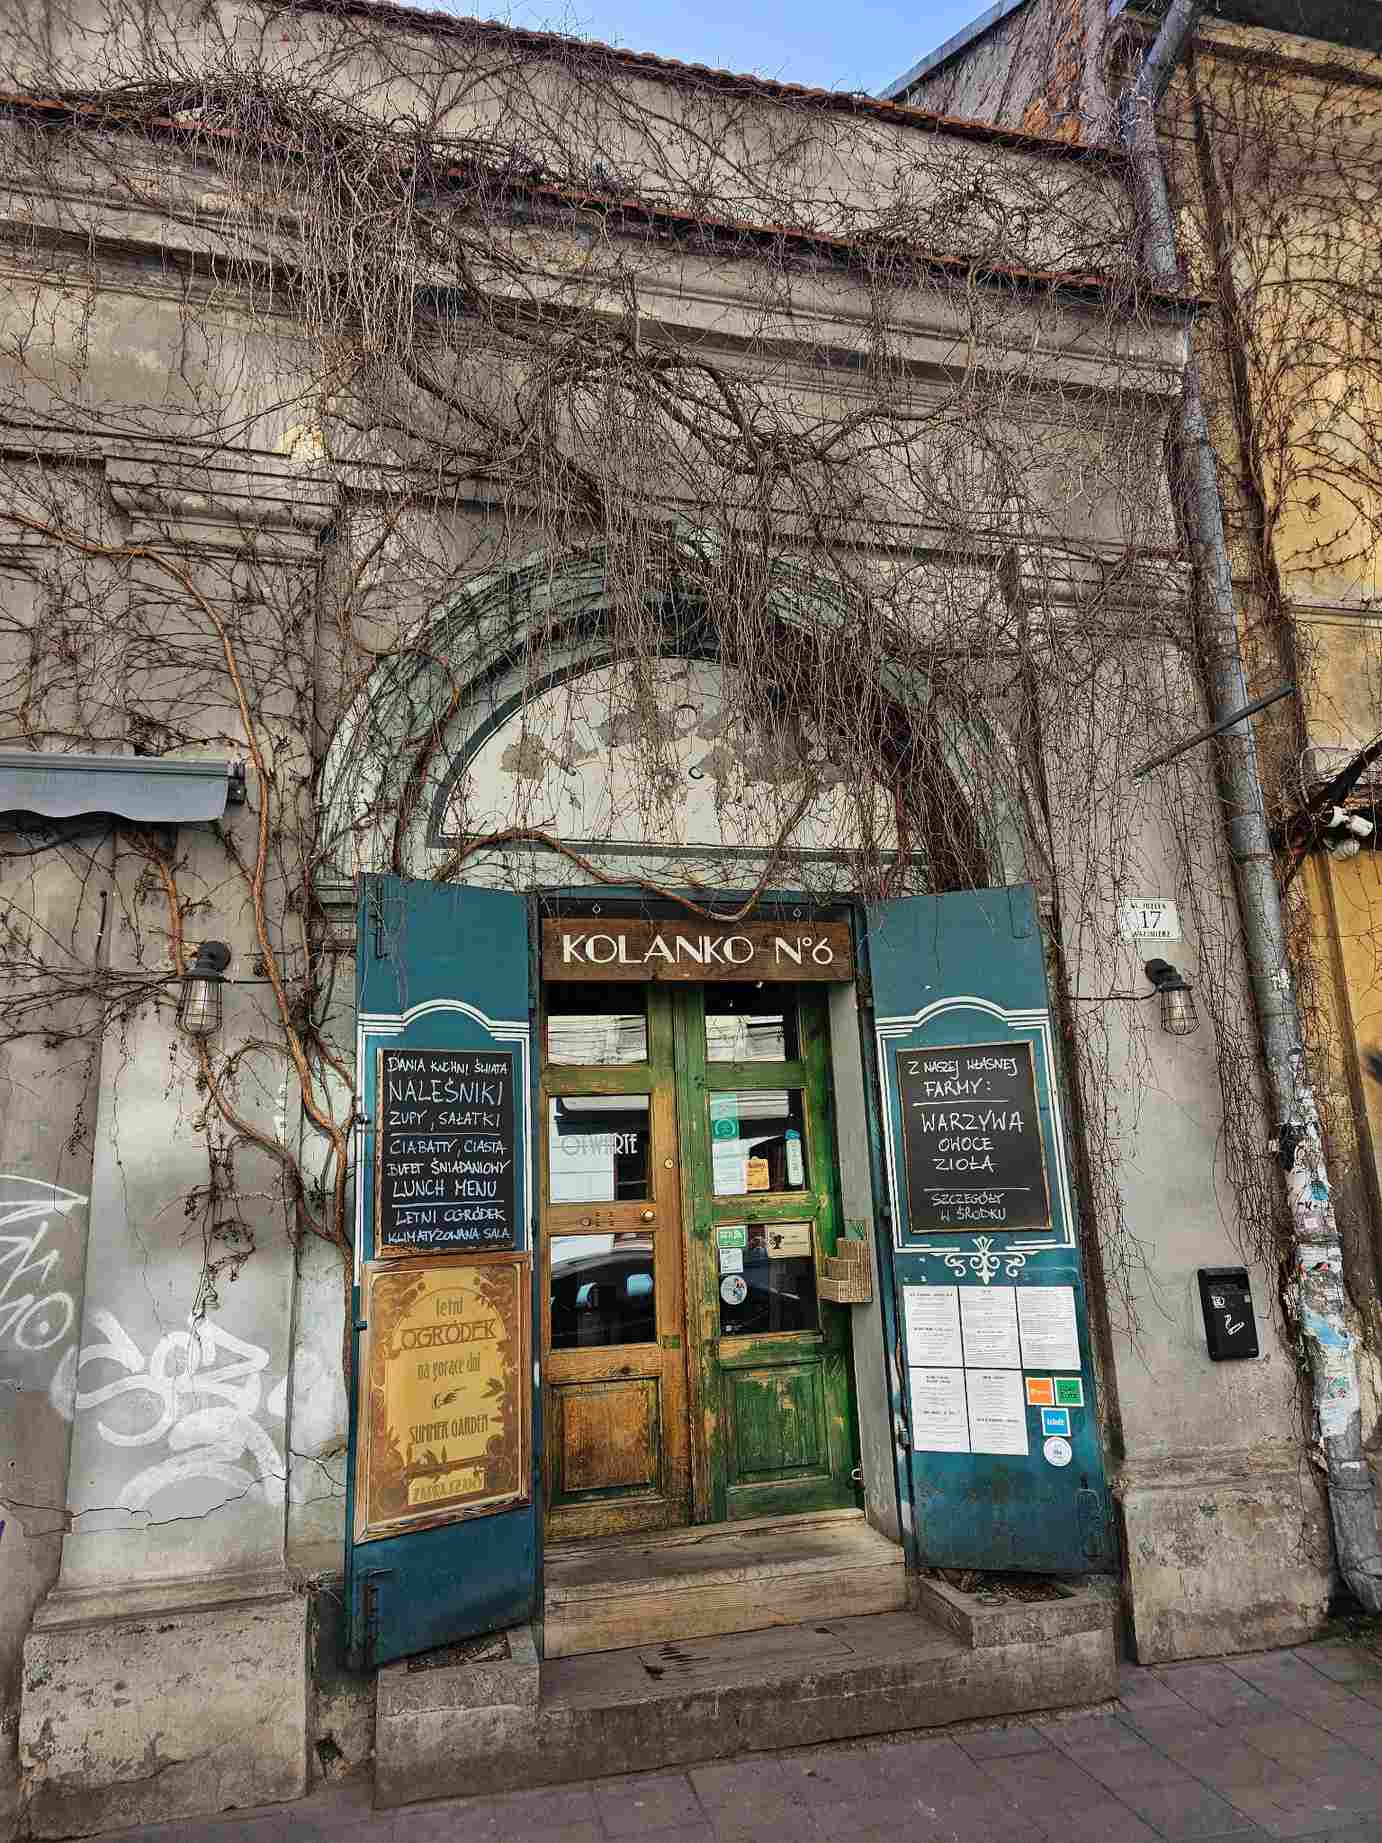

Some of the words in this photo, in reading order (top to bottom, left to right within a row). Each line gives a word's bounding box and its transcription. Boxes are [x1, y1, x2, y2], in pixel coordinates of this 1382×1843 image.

[1140, 911, 1162, 928] 17
[563, 934, 754, 964] KOLANKO
[386, 1056, 425, 1073] DANIA
[430, 1061, 469, 1076] KUCHNI
[907, 1061, 921, 1075] Z
[924, 1060, 960, 1080] NASZEJ
[389, 1077, 503, 1106] NALEŚNIKI
[921, 1109, 1025, 1134] WARZYWA
[463, 1140, 509, 1156] CIASTA
[937, 1136, 995, 1152] OWOCE
[386, 1162, 424, 1177] BUFET
[932, 1155, 1000, 1173] ZIOŁA
[392, 1179, 445, 1198] LUNCH
[455, 1180, 497, 1197] MENU
[396, 1210, 437, 1226] LETNI
[444, 1206, 506, 1221] OGRÓDEK
[388, 1229, 480, 1244] KLIMATYZOWANA
[484, 1229, 511, 1240] SALA
[435, 1296, 464, 1317] letni
[401, 1318, 497, 1350] OGRÓDEK
[409, 1422, 449, 1445] SUMMER
[451, 1414, 489, 1437] GARDEN
